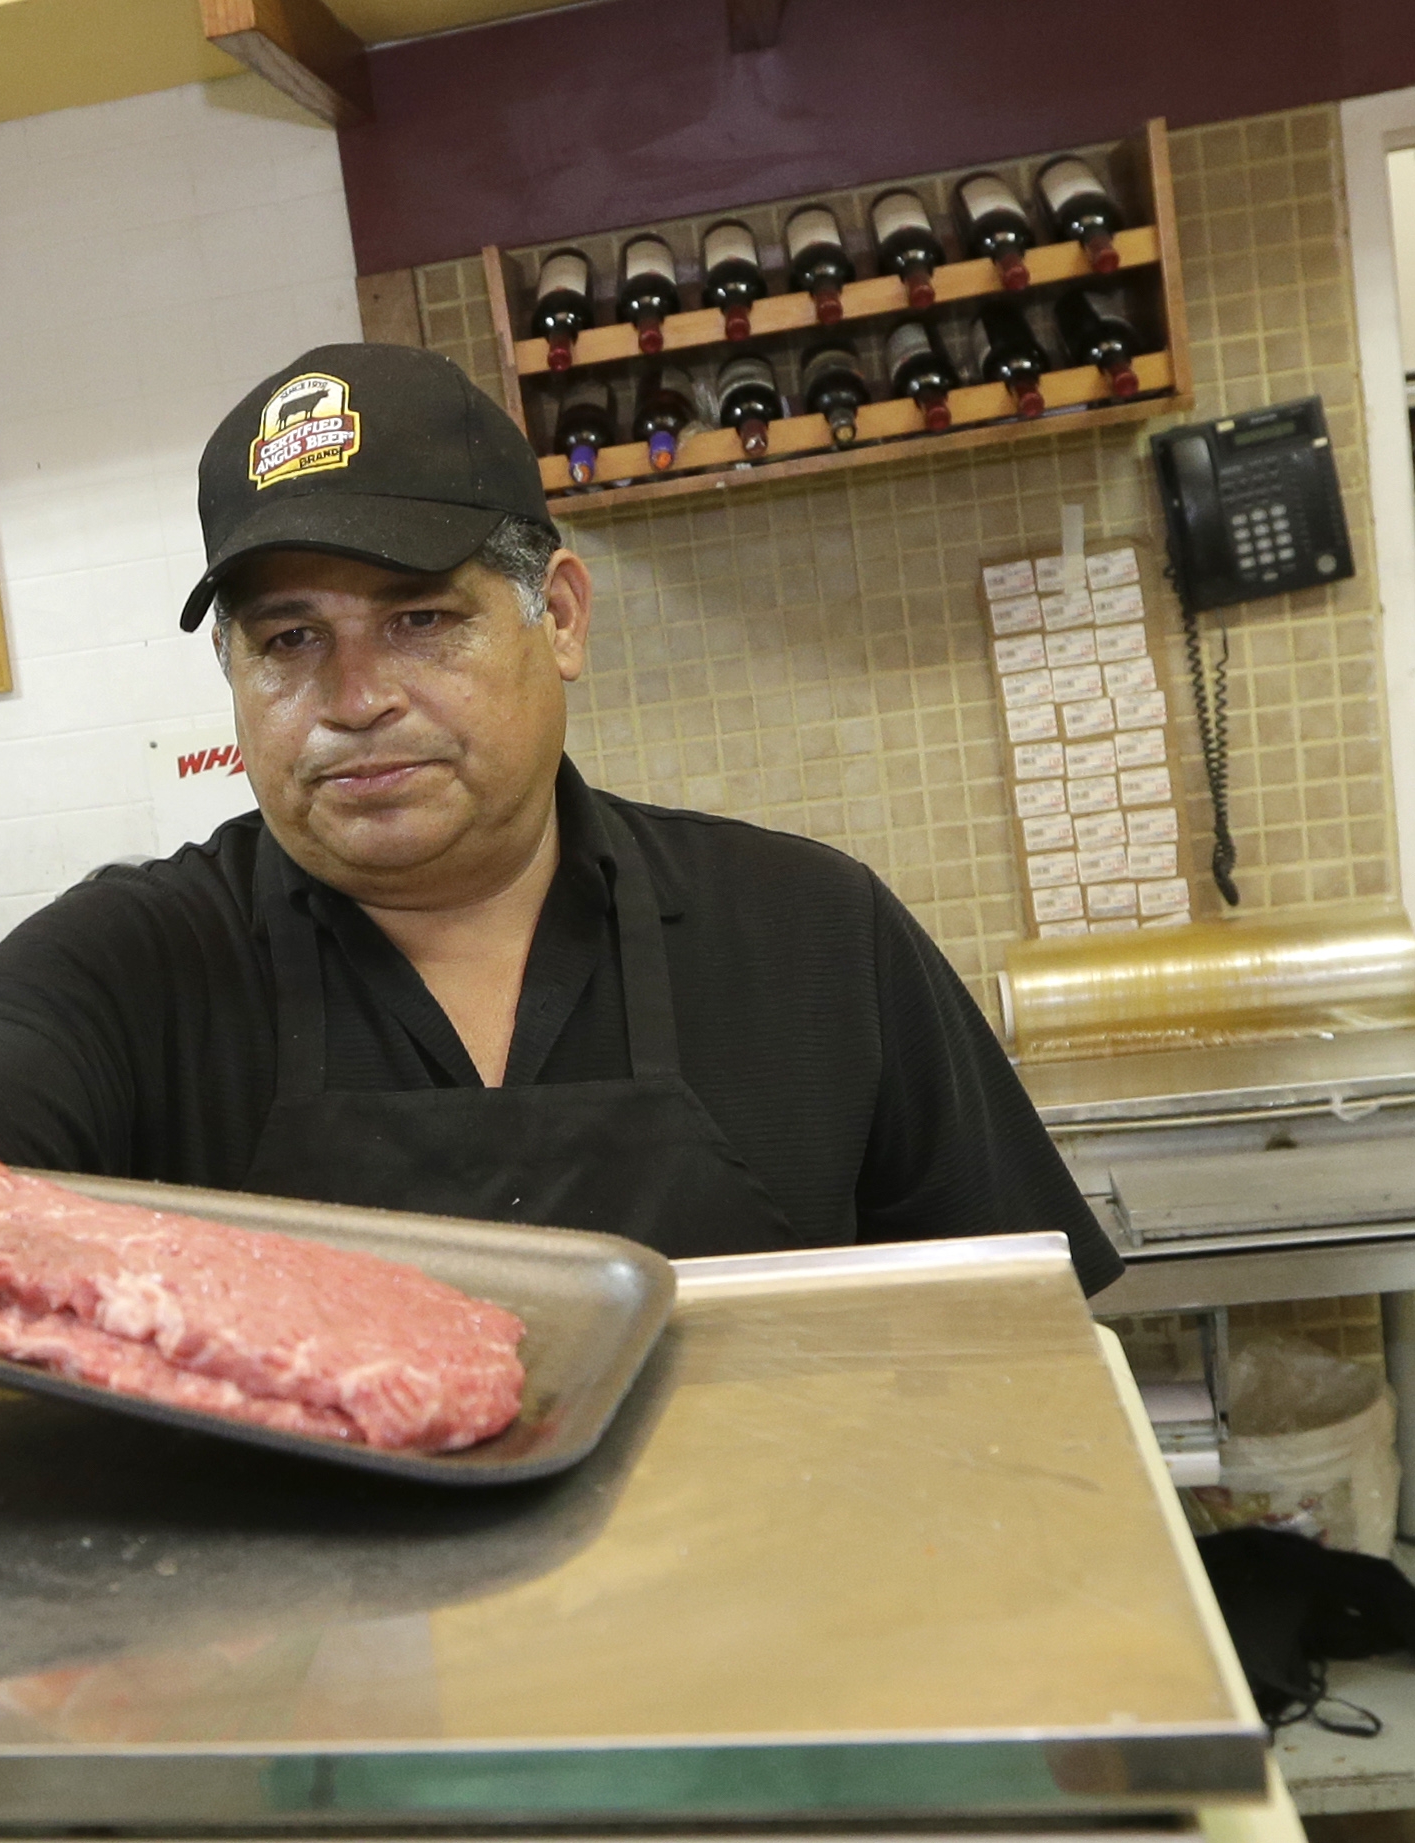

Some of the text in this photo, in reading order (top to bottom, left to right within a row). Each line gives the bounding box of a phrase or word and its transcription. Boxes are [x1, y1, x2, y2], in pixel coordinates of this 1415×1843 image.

[260, 417, 343, 458] CERTIFIED
[255, 440, 302, 475] ANGUS
[299, 448, 340, 468] BRAND
